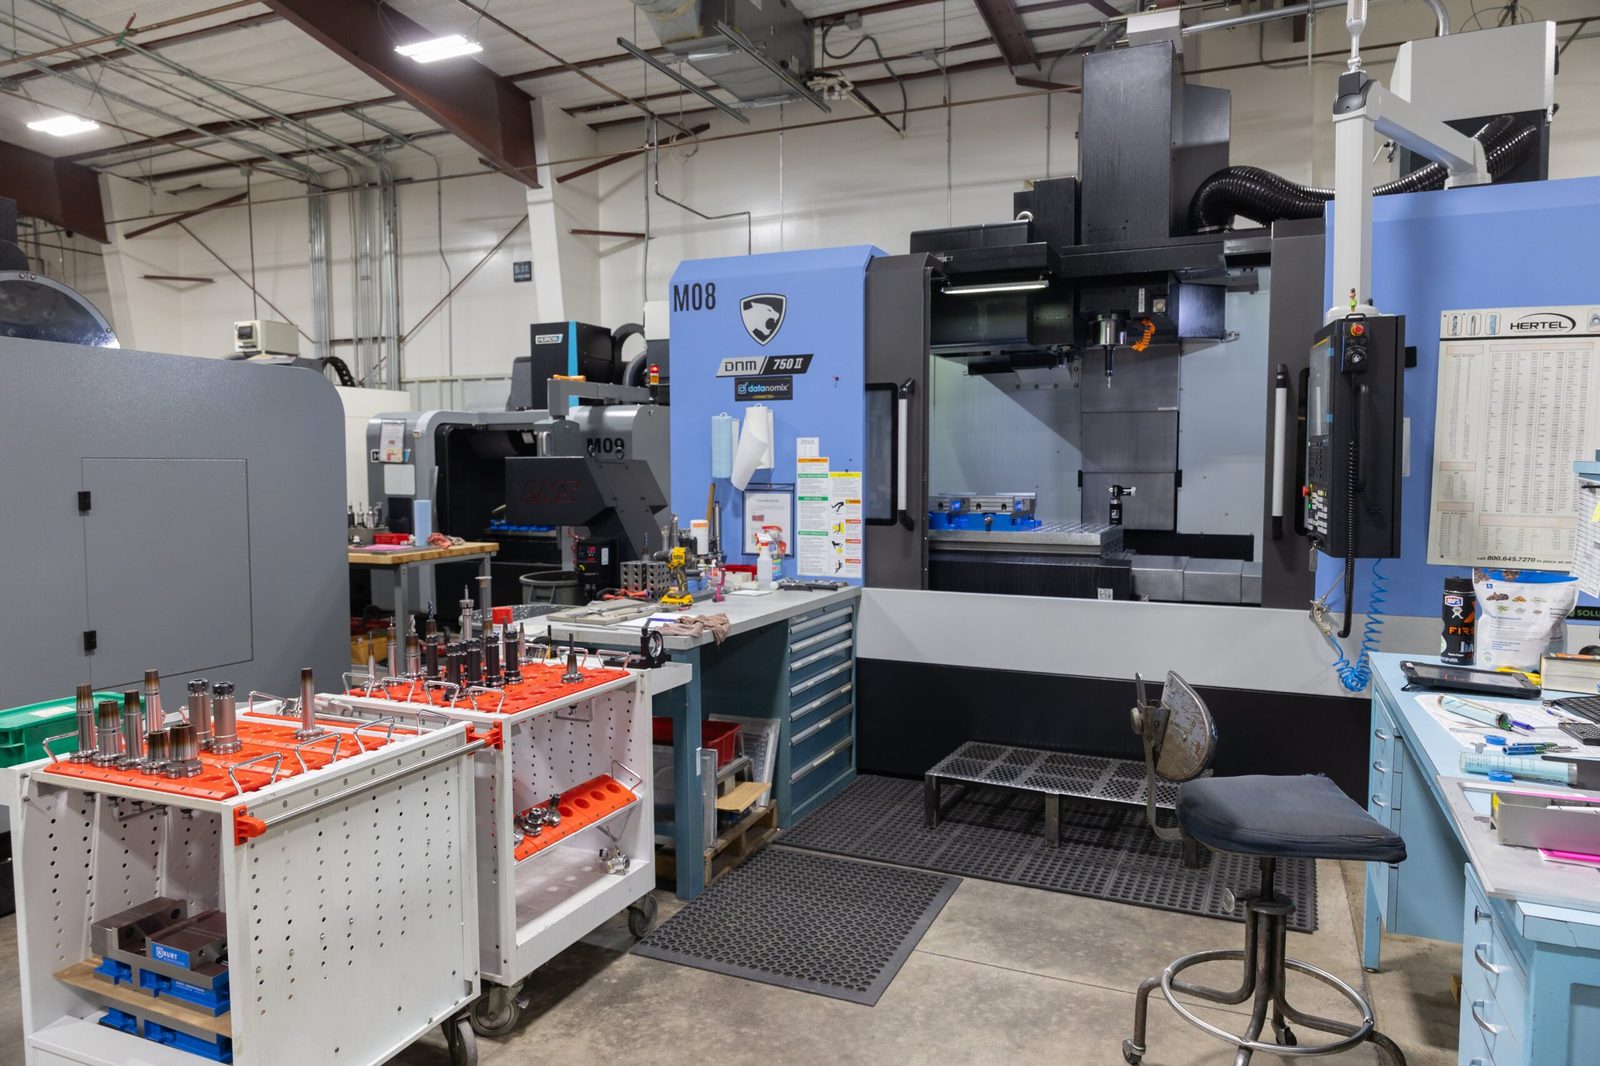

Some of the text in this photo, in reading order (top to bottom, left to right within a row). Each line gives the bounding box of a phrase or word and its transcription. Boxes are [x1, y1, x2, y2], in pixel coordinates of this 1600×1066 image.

[673, 282, 716, 312] M08
[1510, 321, 1568, 330] HERTEL
[747, 383, 788, 393] datanomix
[586, 438, 625, 454] M09
